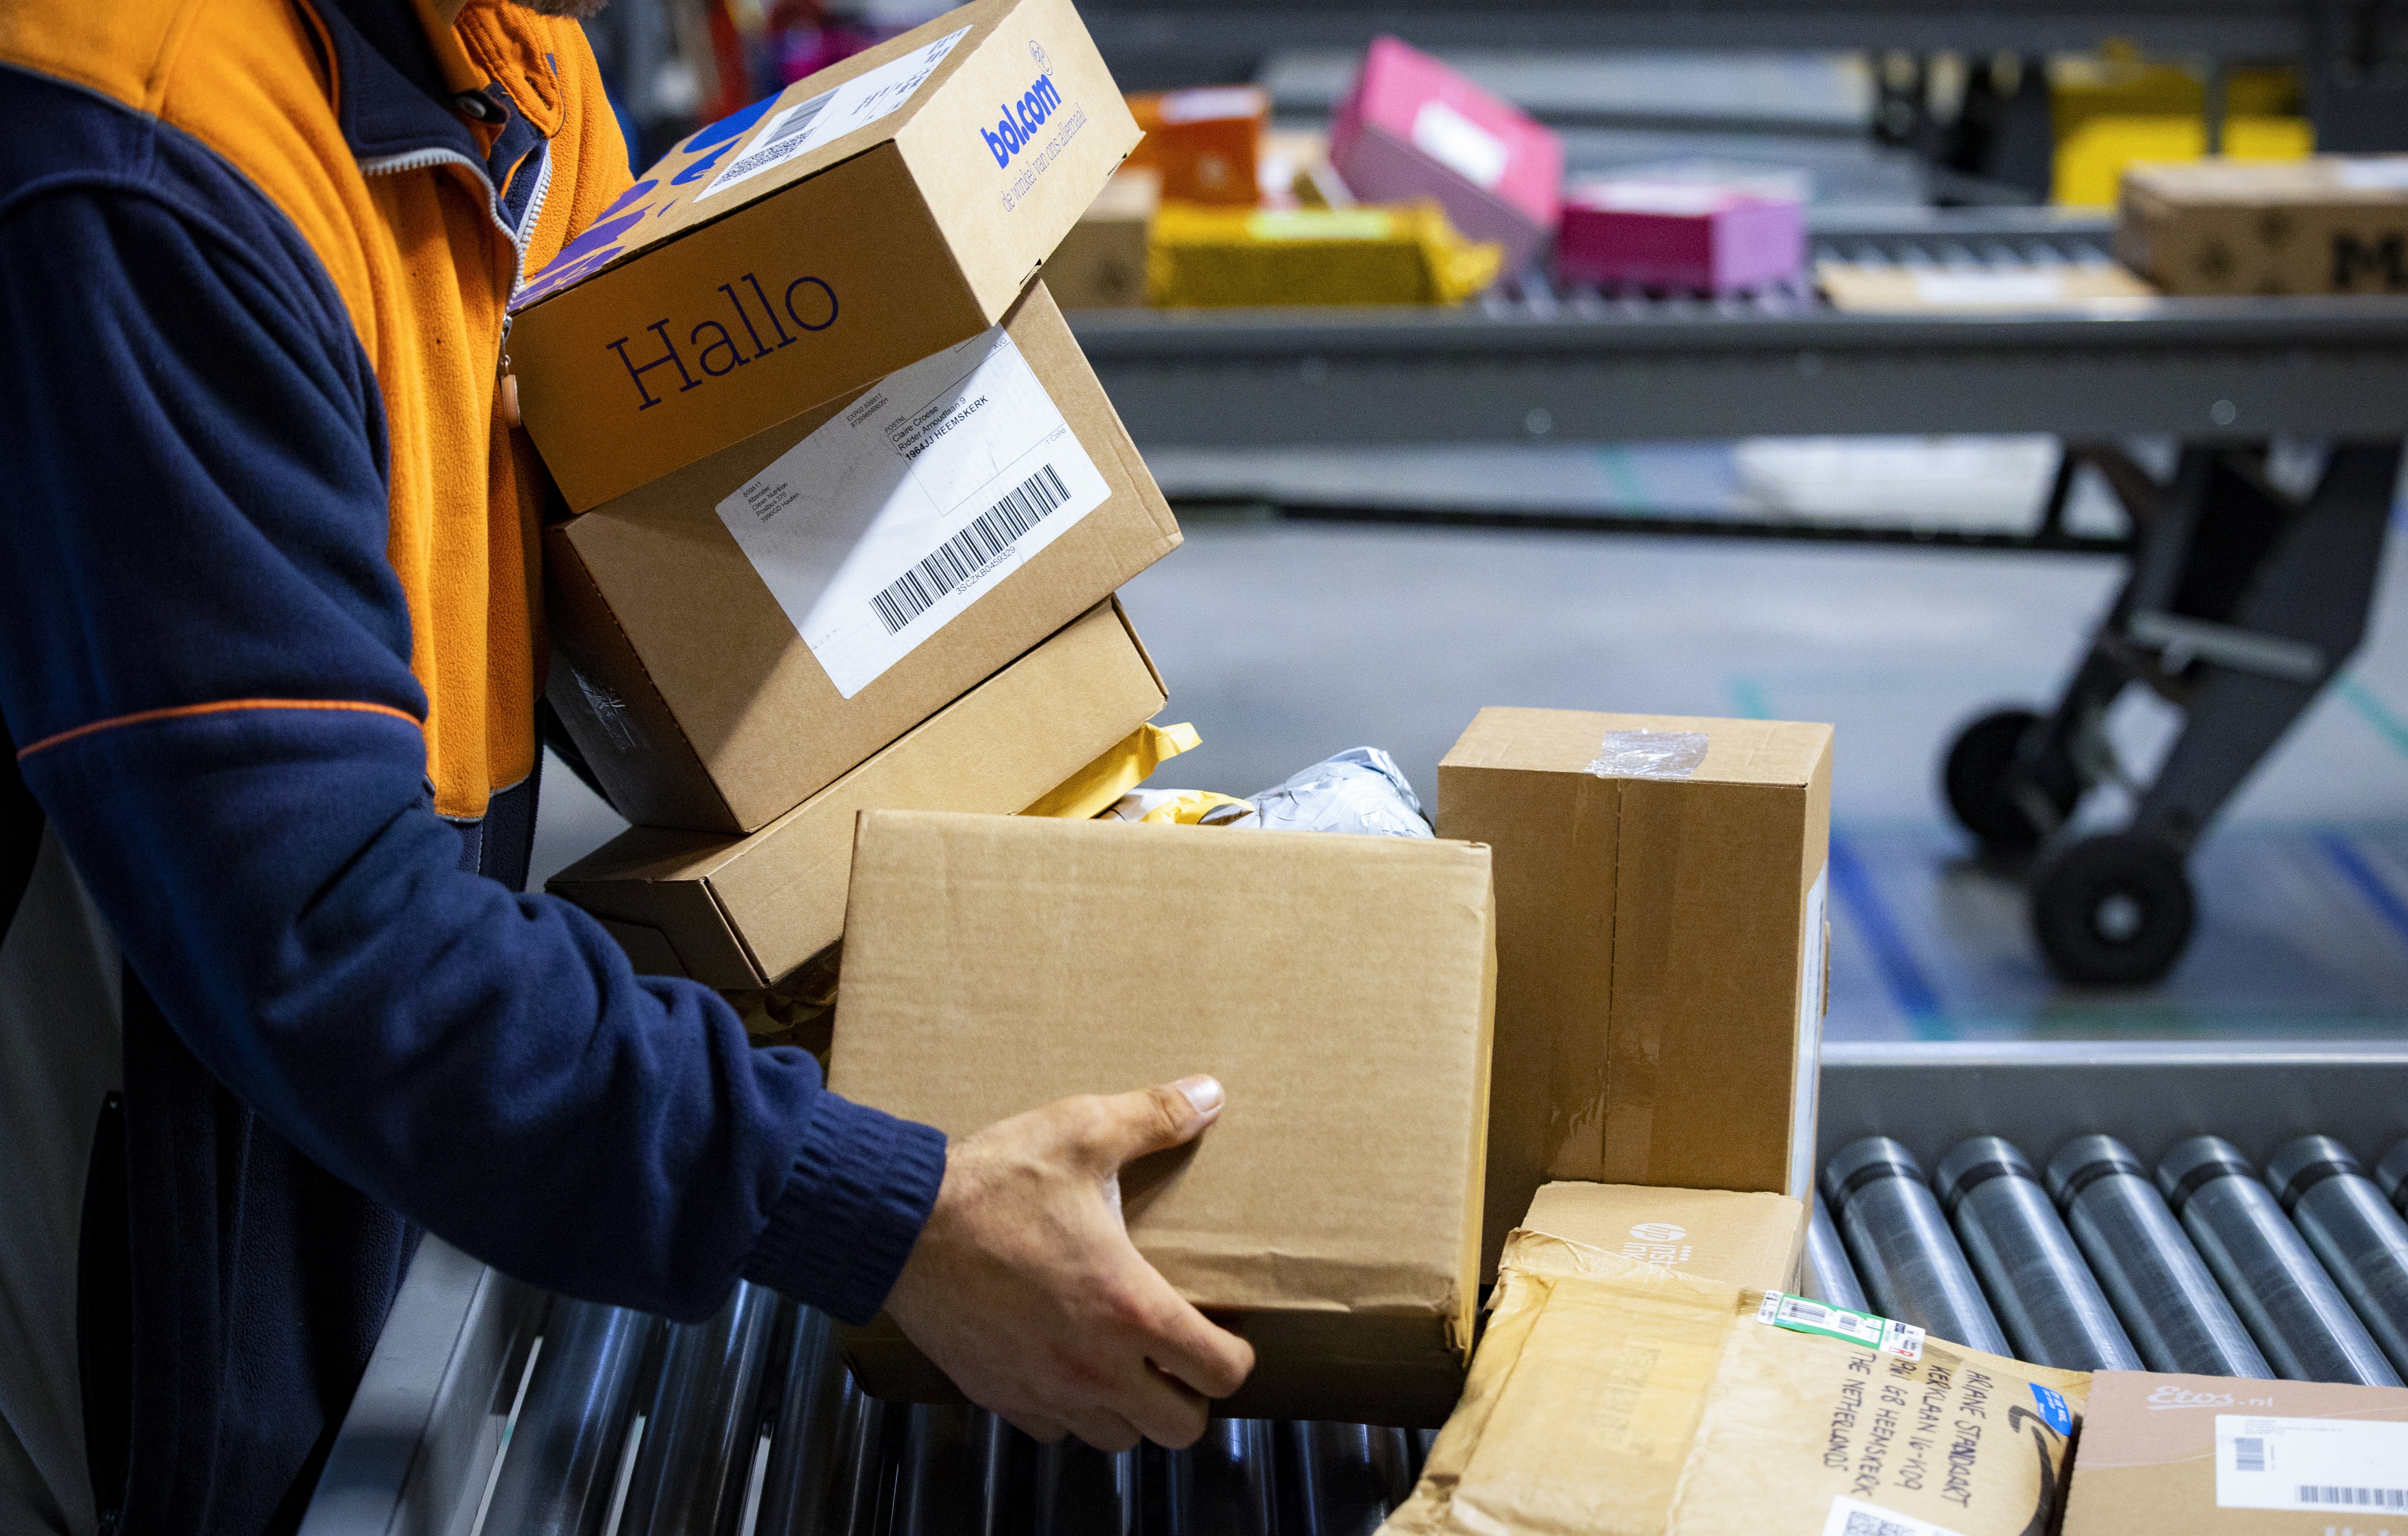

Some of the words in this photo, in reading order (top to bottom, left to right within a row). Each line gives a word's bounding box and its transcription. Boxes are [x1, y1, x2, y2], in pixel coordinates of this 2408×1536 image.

[980, 74, 1061, 170] bol.com
[1001, 191, 1015, 212] de
[1011, 161, 1037, 202] winkel
[1032, 153, 1050, 175] van
[1046, 140, 1062, 161] ons
[1058, 103, 1087, 147] allemaal
[606, 273, 839, 411] Hallo
[993, 337, 1007, 351] AVG
[863, 393, 882, 409] 809811
[884, 415, 907, 433] POSTNL
[892, 425, 914, 444] Claire
[912, 406, 939, 427] Croese
[898, 431, 922, 452] Ridder
[959, 396, 966, 405] 9
[905, 436, 935, 461] 1964JJ
[934, 395, 989, 440] HEEMSKERK
[1050, 428, 1066, 443] Collo
[752, 498, 768, 510] Clean
[767, 482, 789, 500] Nutrition
[756, 500, 777, 517] Postbus
[955, 546, 1016, 595] 3SCZKB0459329
[1630, 1223, 1687, 1241] hp
[1848, 1351, 1877, 1375] THE
[1916, 1364, 1953, 1434] KERKLAAN
[1960, 1369, 1994, 1419] ARIANE
[1823, 1378, 1866, 1473] NETHERLANDS
[1850, 1408, 1900, 1497] HEEMSKERK
